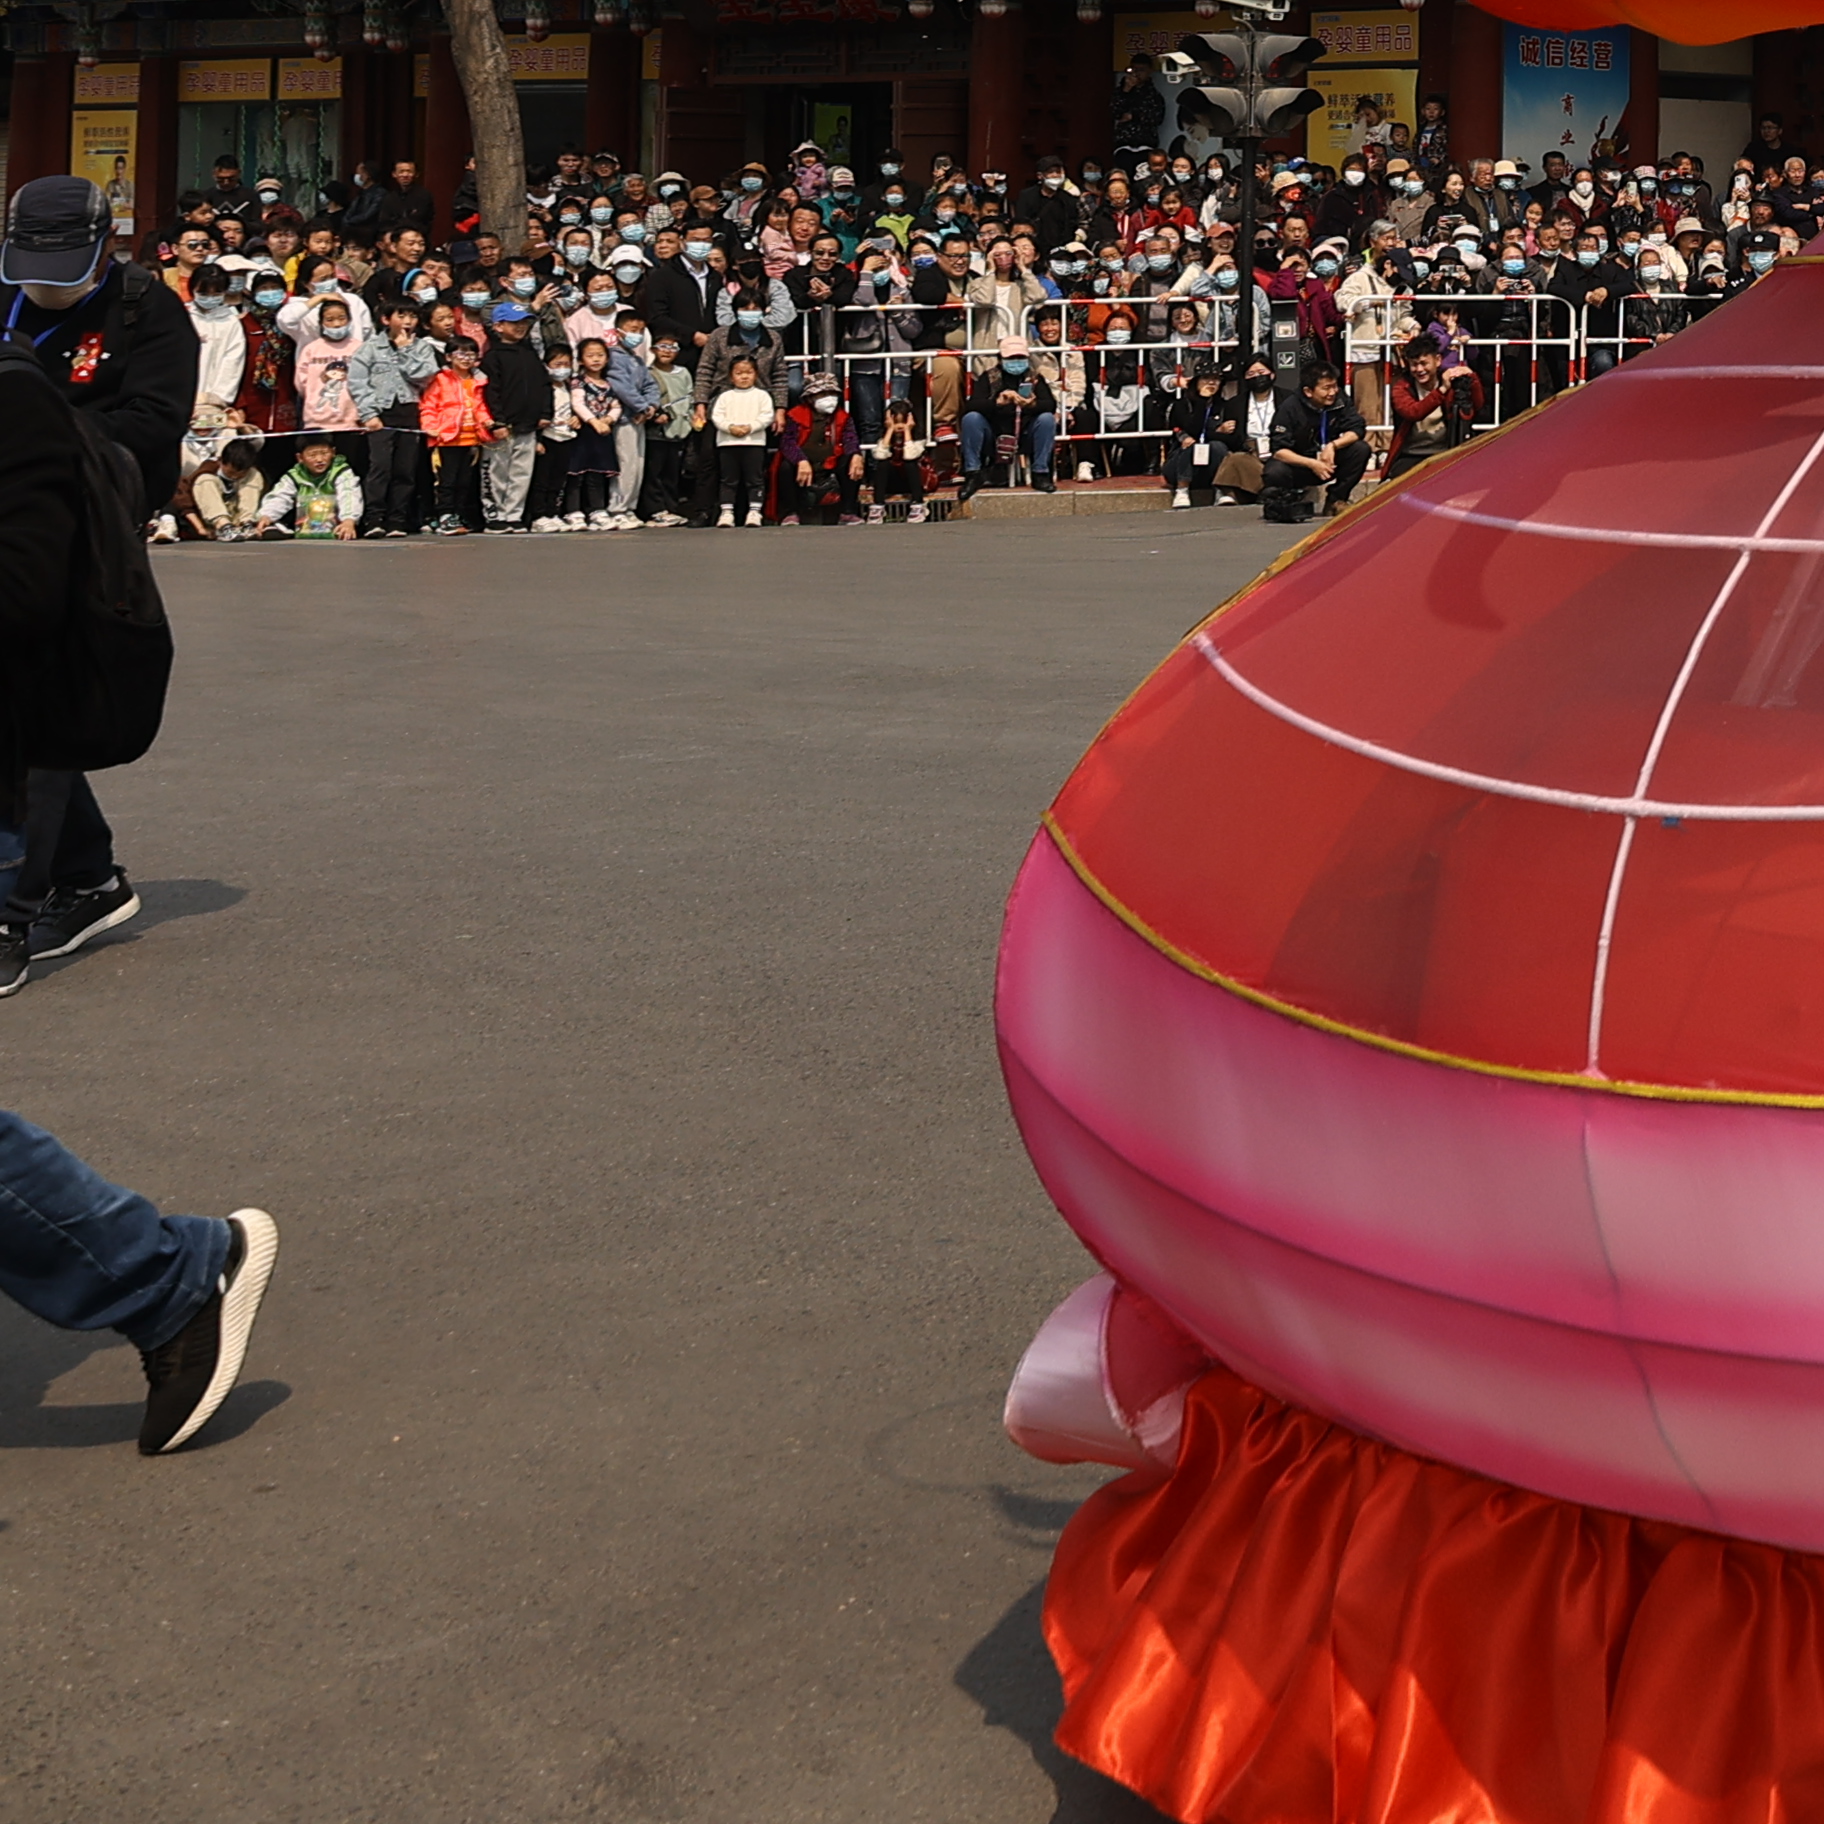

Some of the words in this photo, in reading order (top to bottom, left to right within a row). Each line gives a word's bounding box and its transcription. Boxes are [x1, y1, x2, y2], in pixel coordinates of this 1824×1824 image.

[1317, 24, 1412, 53] 孕婴童用品
[509, 46, 587, 72] 孕婴童用品
[1519, 36, 1612, 70] 诚信经营
[186, 71, 266, 93] 孕婴童用品
